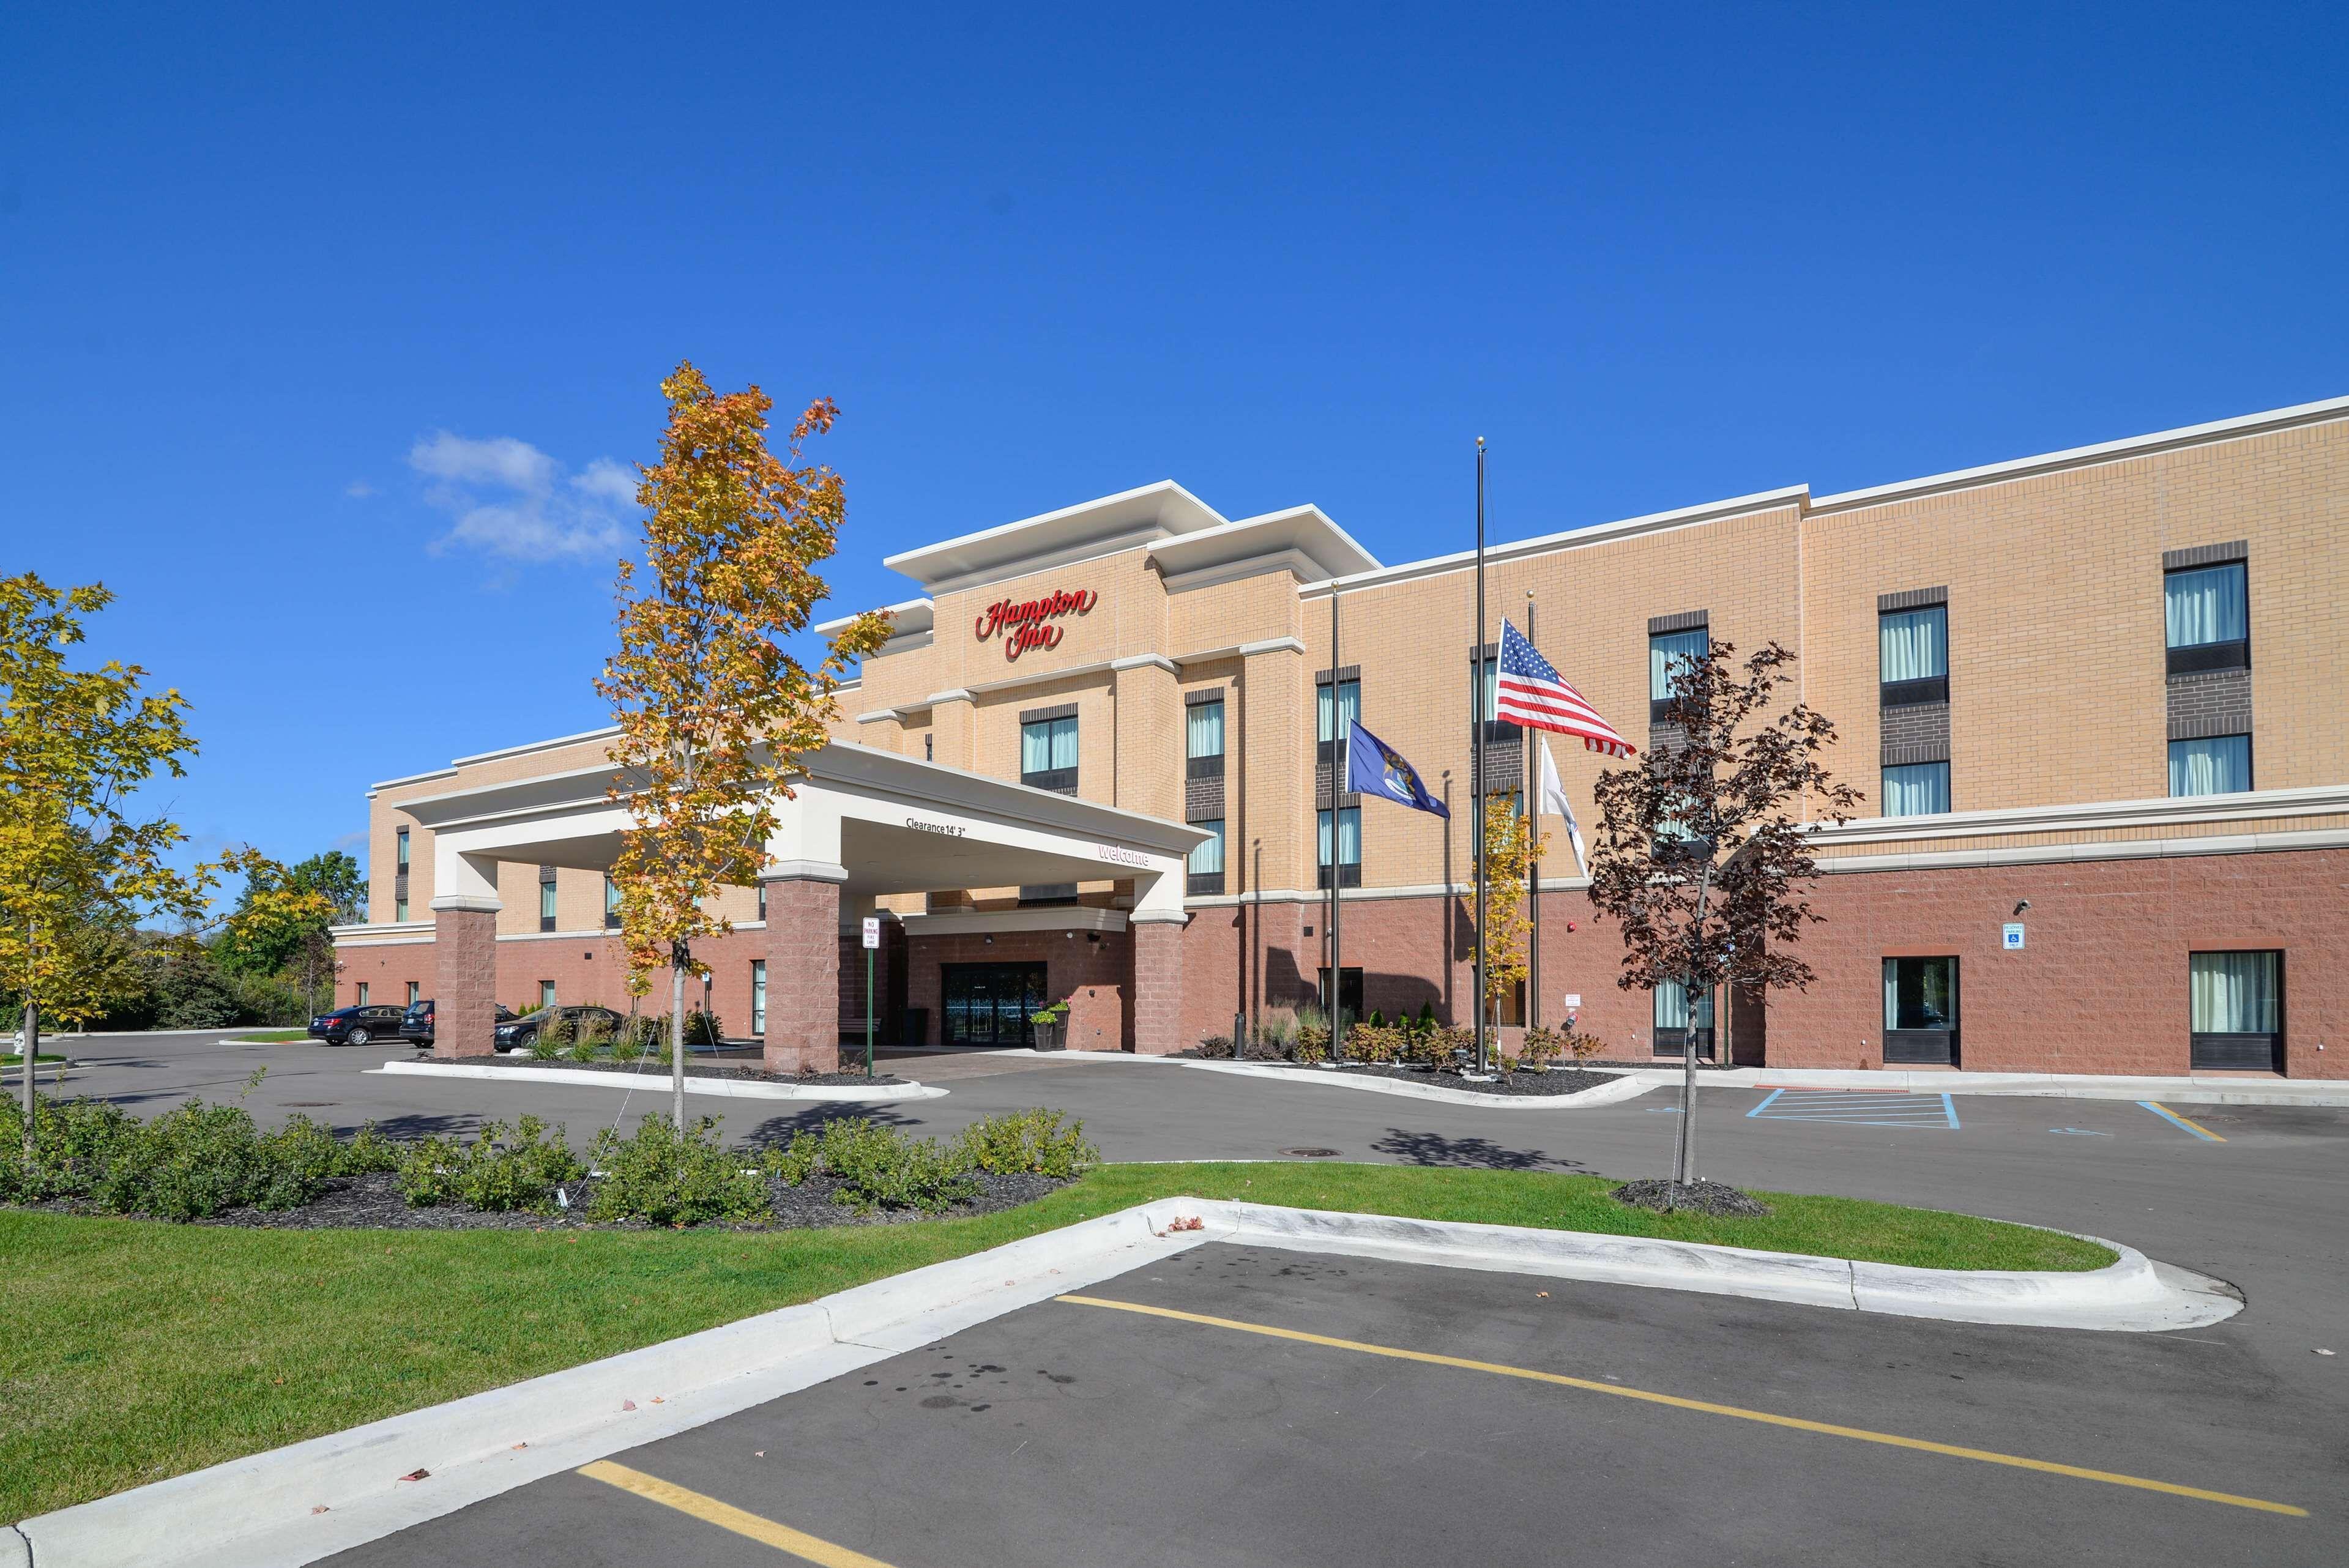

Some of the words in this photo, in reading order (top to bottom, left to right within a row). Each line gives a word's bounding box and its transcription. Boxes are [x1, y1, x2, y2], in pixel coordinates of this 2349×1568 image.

[975, 589, 1097, 637] Hampton
[1005, 622, 1063, 658] Inn
[906, 817, 945, 834] Clearance
[946, 825, 956, 836] 14'
[958, 827, 966, 837] 3"
[1097, 843, 1149, 866] welcome
